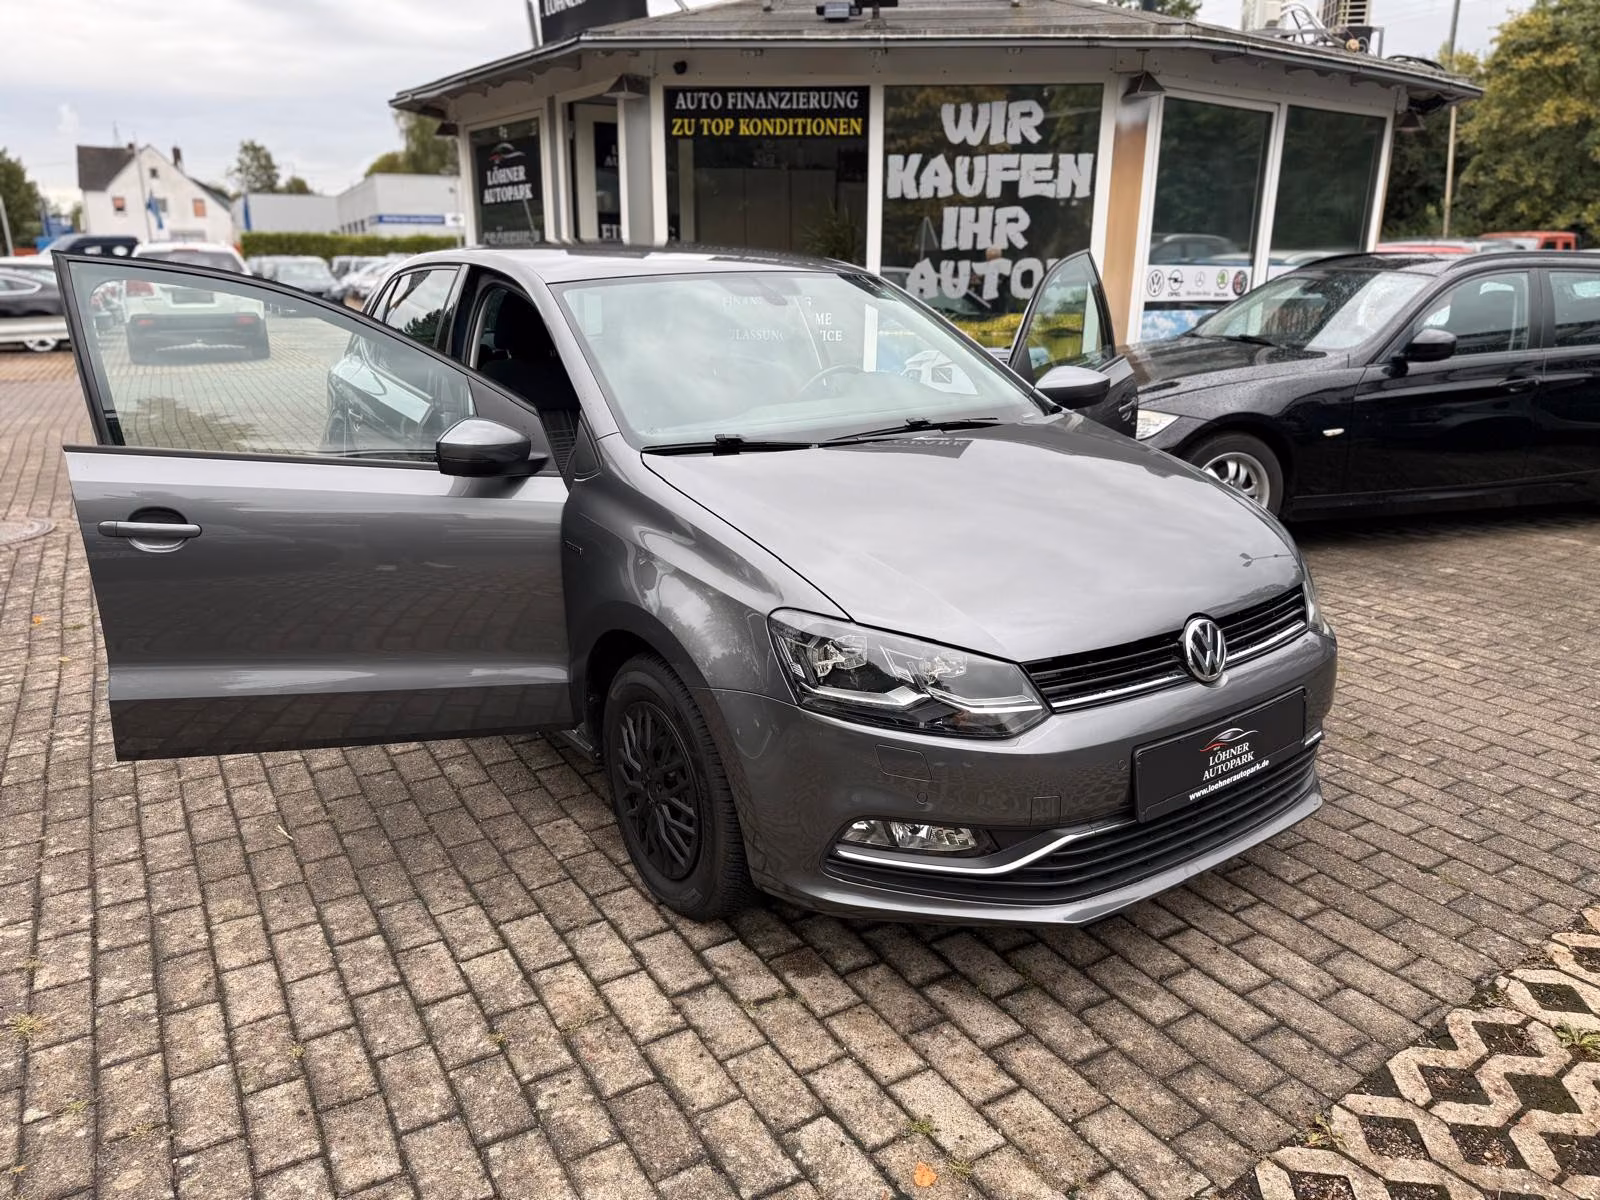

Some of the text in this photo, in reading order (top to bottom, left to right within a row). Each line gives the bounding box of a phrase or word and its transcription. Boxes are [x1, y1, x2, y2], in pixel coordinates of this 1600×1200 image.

[675, 91, 859, 110] AUTO FINANZIERUNG
[672, 118, 863, 136] ZU TOP KONDITIONEN
[941, 100, 1045, 146] WIR
[487, 165, 526, 186] LÖHNER
[886, 153, 1095, 199] KAUFEN
[483, 183, 533, 204] AUTOPARK
[941, 206, 1031, 250] IHR
[906, 257, 1059, 300] AUTO
[1203, 751, 1255, 781] AUTOPARK
[1209, 742, 1249, 767] LÖHNER
[1189, 759, 1270, 801] www.loehnerautopark.de
